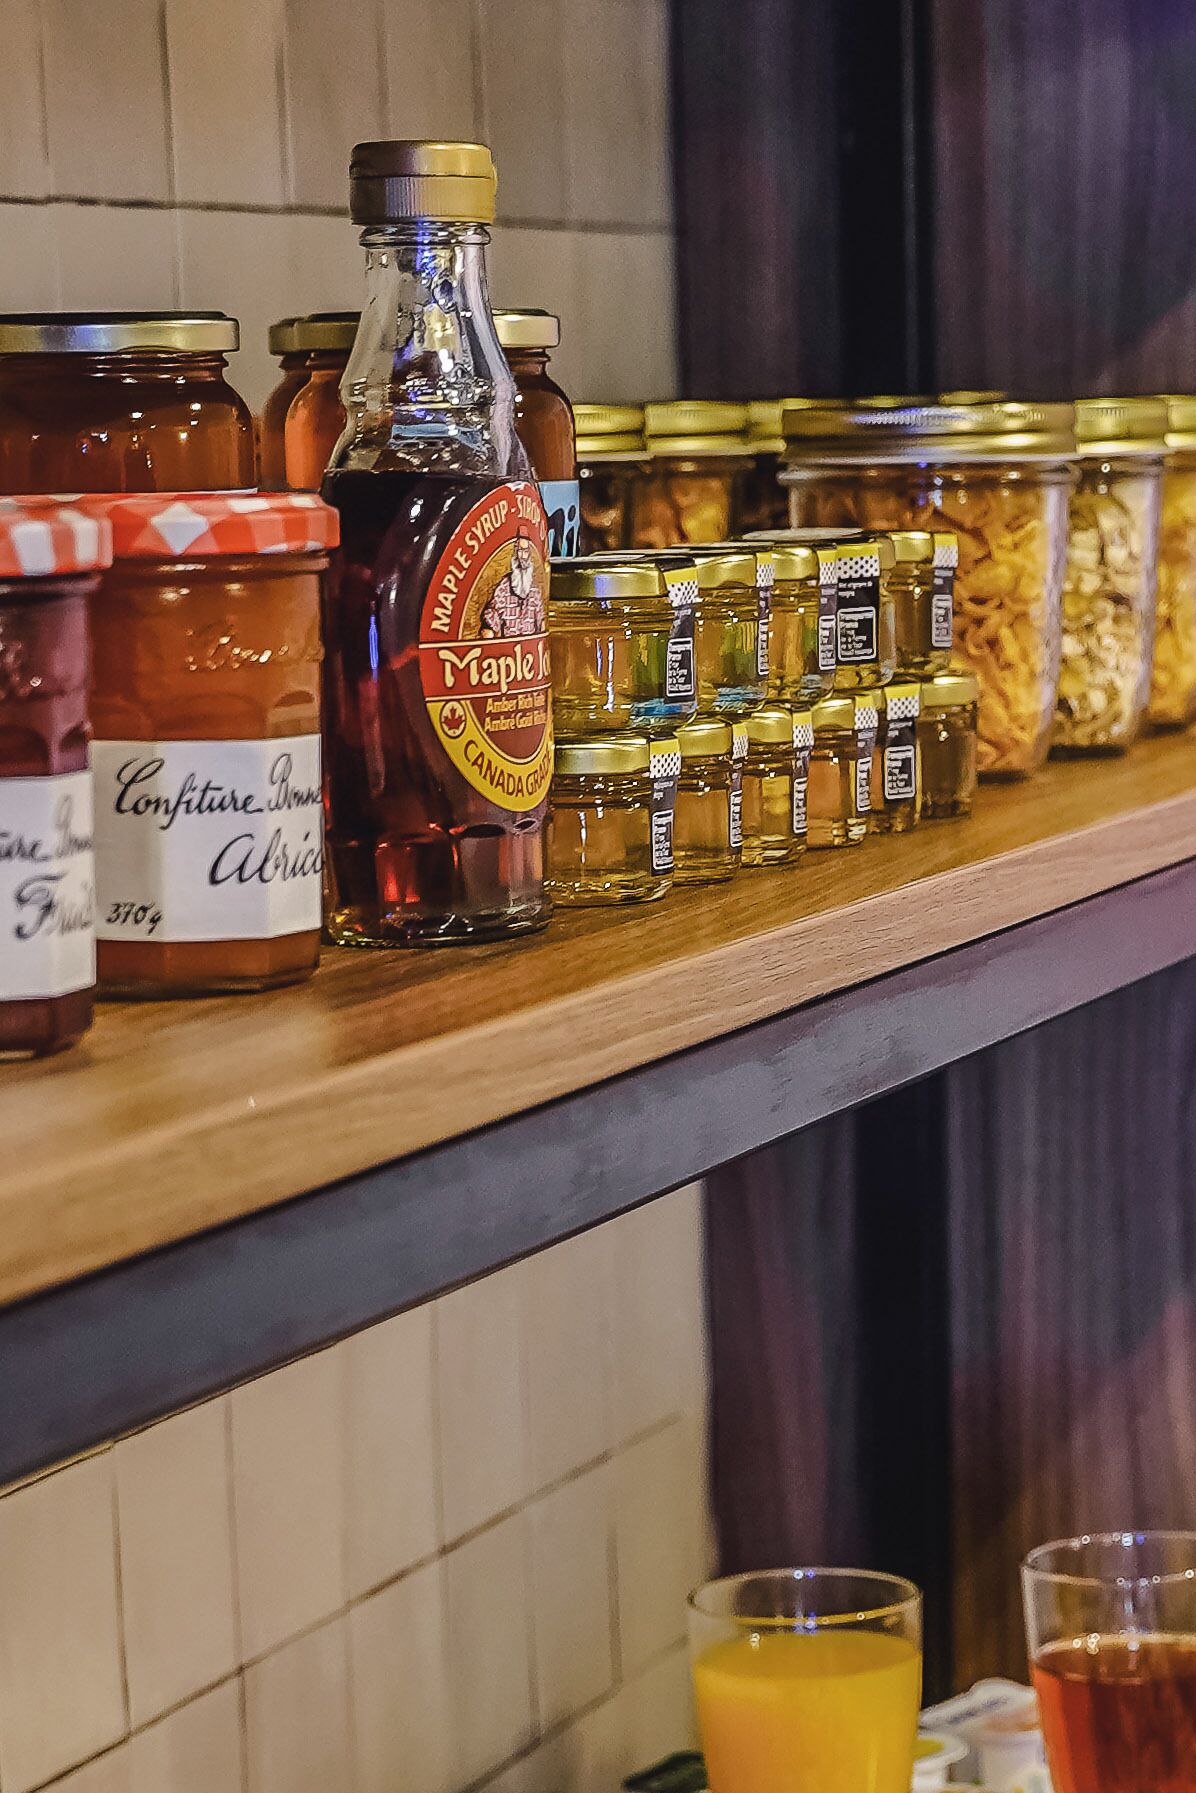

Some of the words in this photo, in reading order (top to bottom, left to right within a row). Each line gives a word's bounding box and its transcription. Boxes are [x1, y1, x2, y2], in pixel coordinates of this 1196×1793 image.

[431, 547, 472, 634] MAPLE
[464, 500, 509, 555] SYRUP
[438, 643, 535, 694] Maple
[484, 713, 516, 732] Ambré
[486, 695, 517, 714] Amber
[114, 757, 264, 830] Confiture
[463, 739, 525, 797] CANADA
[209, 827, 322, 886] Abrico
